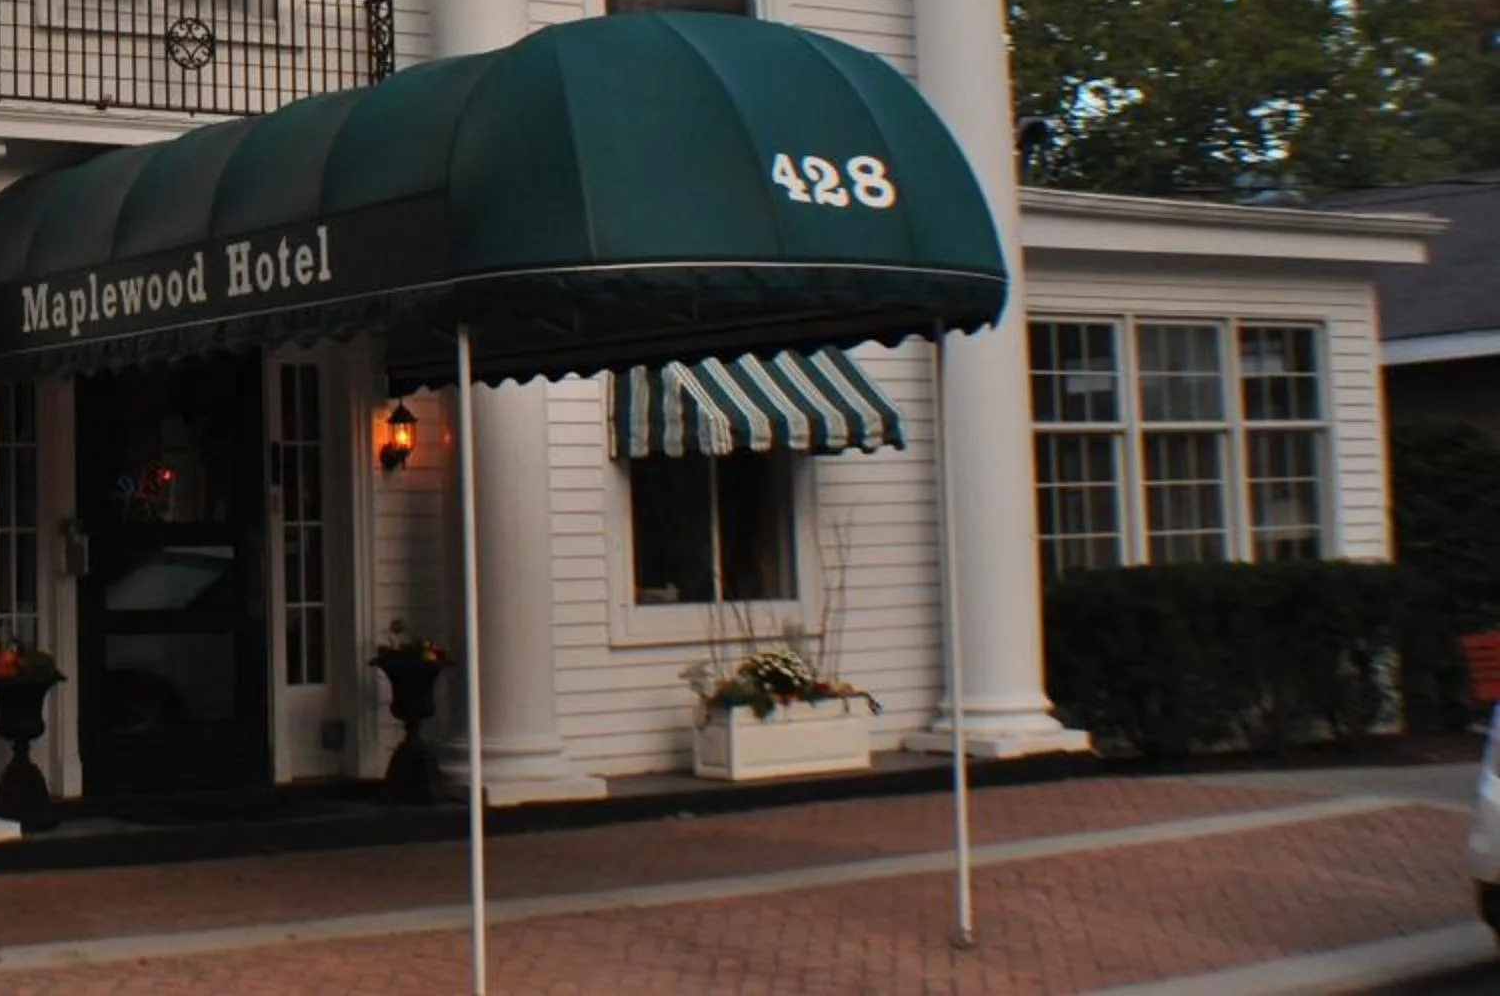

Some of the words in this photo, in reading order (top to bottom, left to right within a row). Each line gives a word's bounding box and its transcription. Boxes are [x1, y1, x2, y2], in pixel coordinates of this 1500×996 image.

[771, 152, 897, 209] 428
[21, 252, 207, 336] Maplewood
[225, 225, 332, 297] Hotel
